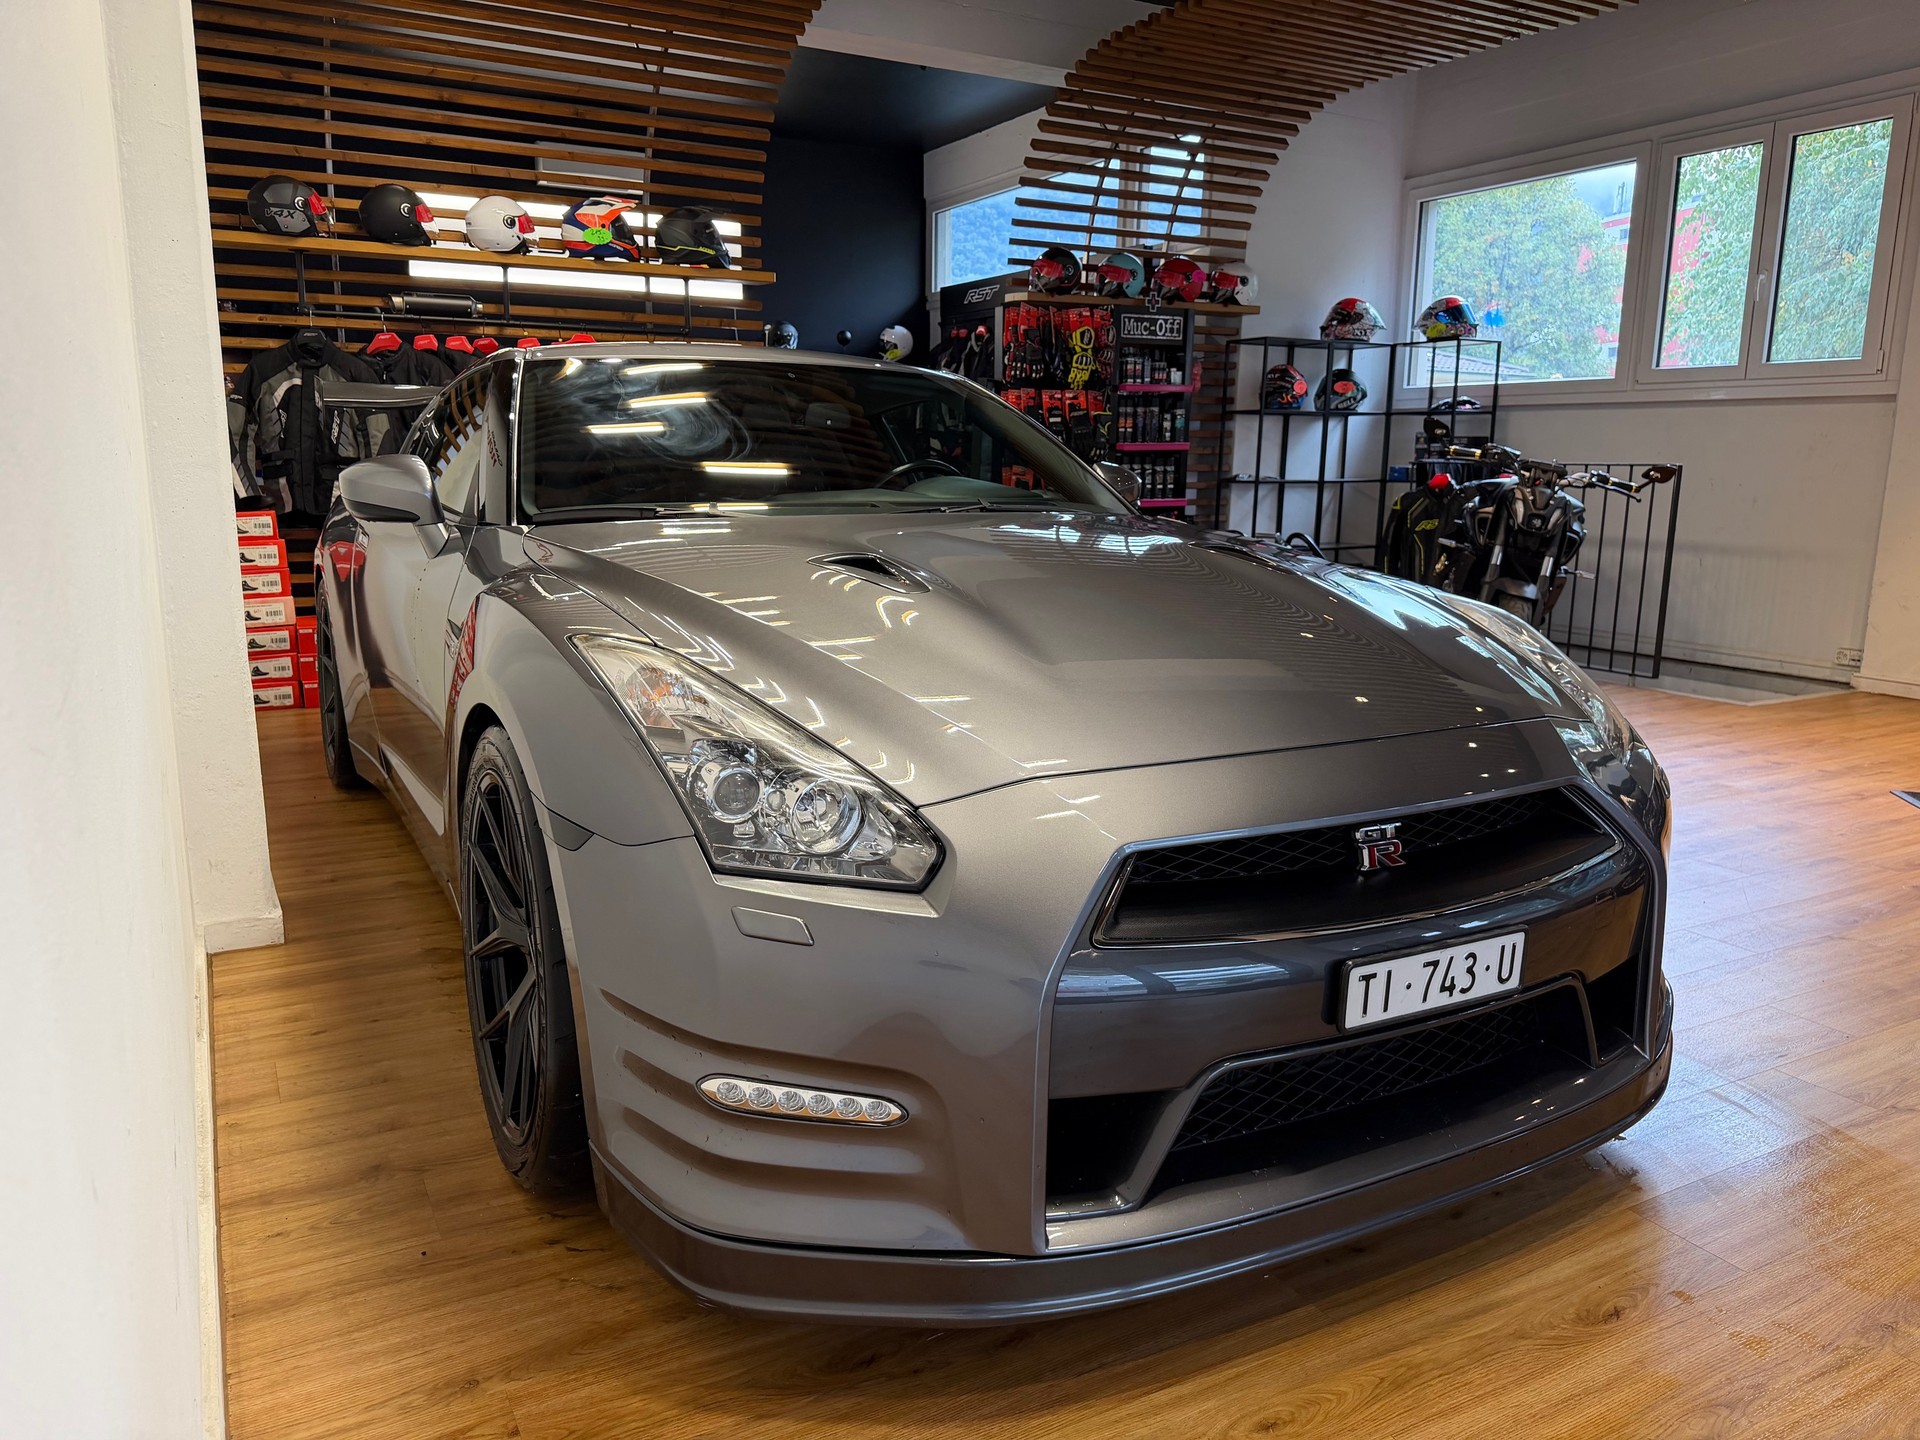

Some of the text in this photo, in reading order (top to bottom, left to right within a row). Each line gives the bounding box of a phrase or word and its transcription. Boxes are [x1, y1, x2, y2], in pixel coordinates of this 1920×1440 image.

[963, 284, 1000, 304] RST
[1123, 318, 1180, 337] Muc-Off
[1355, 821, 1402, 842] GT
[1357, 839, 1407, 872] R
